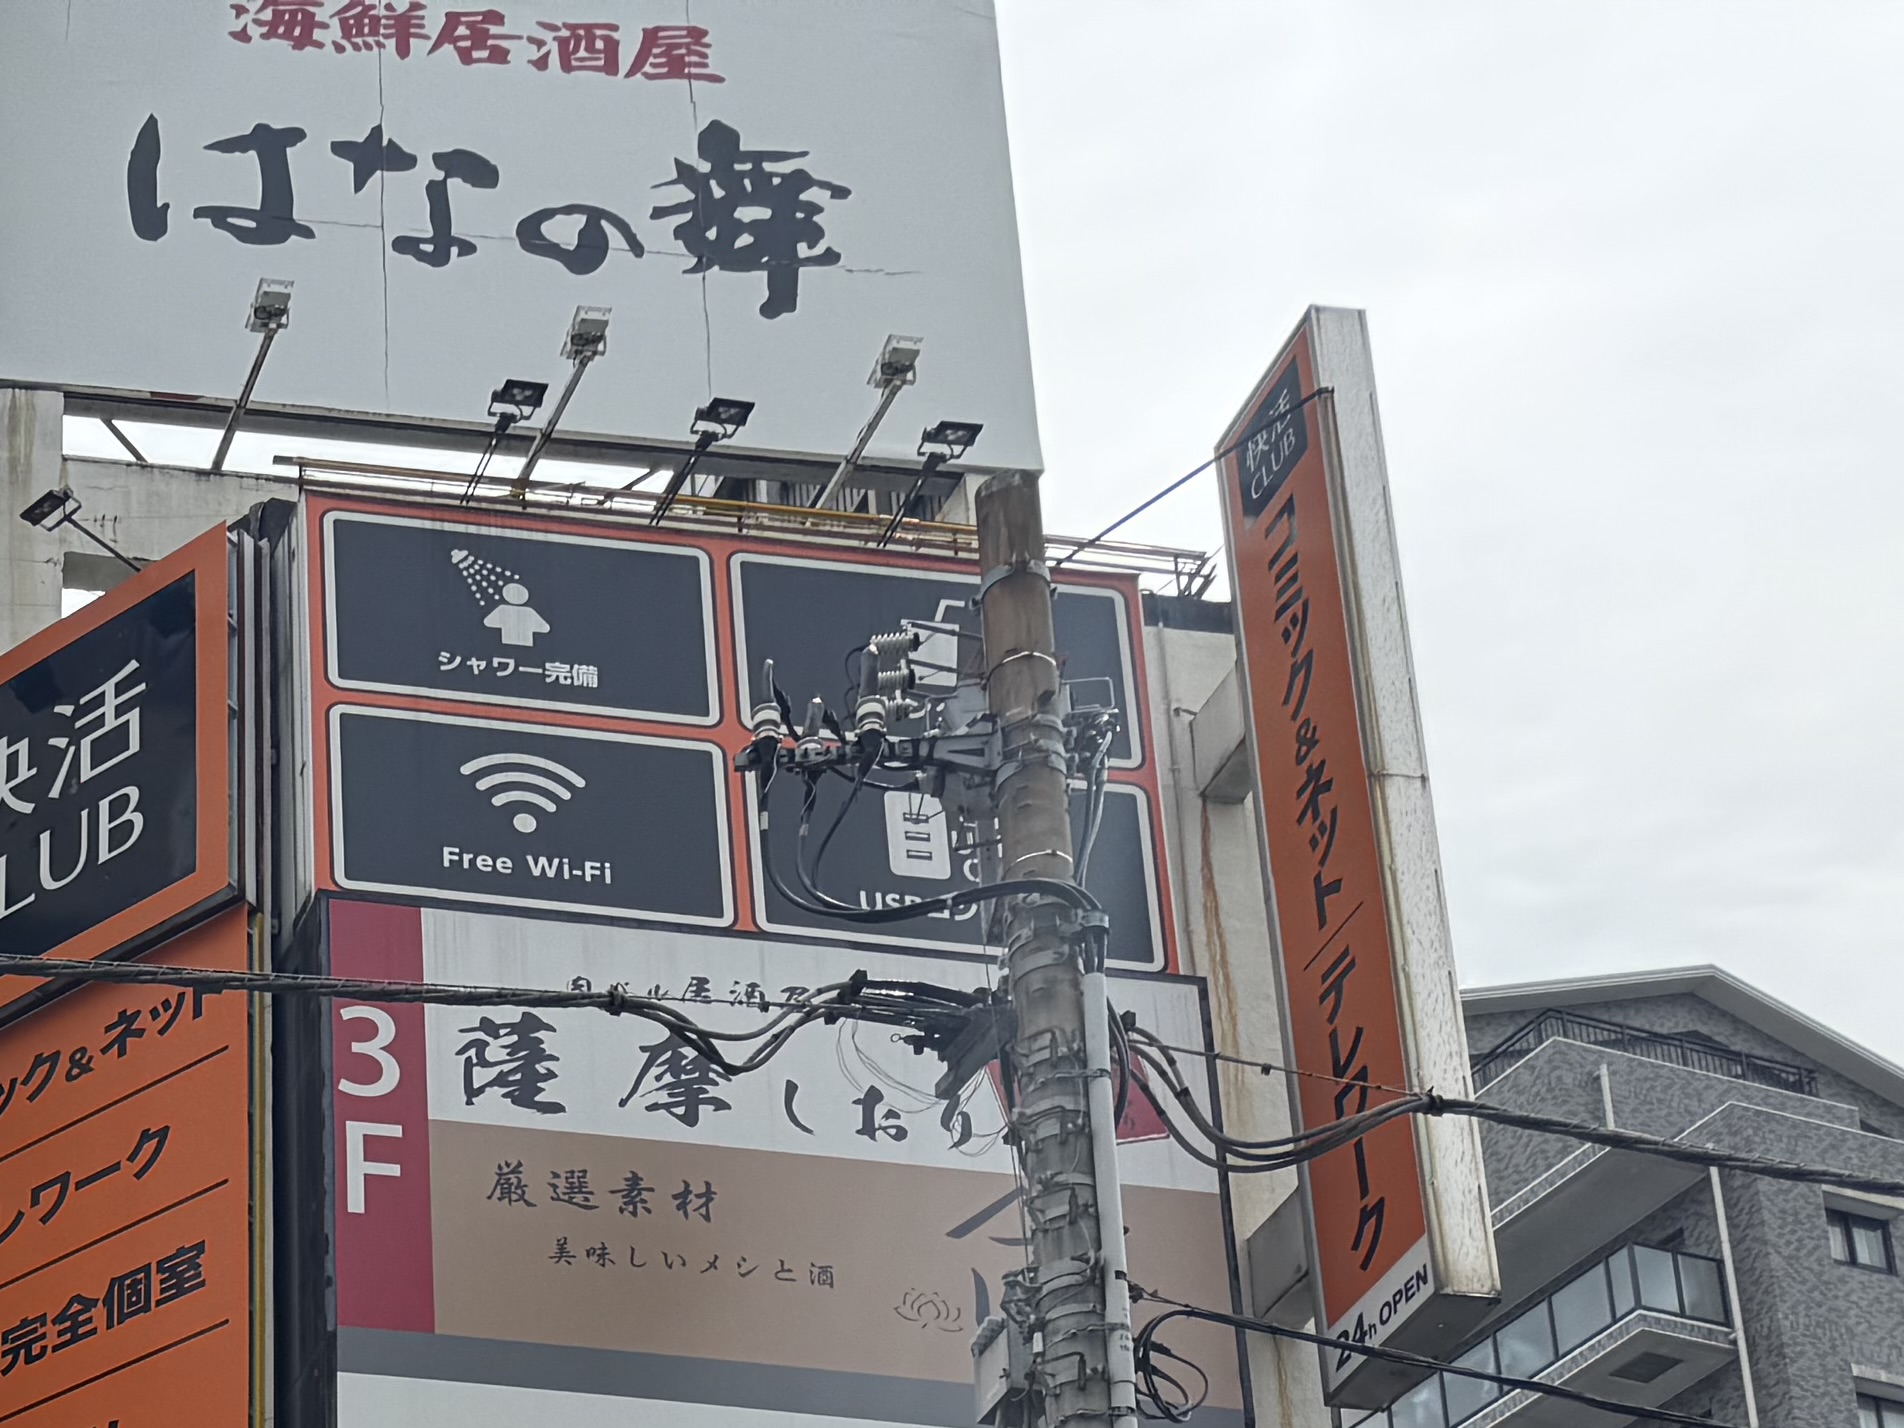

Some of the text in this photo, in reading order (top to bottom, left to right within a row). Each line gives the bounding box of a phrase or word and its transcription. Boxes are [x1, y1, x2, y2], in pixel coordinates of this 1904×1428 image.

[227, 0, 726, 84] 海鮮居酒屋
[126, 112, 852, 320] はなの舞
[1251, 428, 1296, 499] CLUB
[438, 651, 599, 690] シャワー完備
[442, 846, 613, 886] Free Wi-Fi
[486, 1160, 719, 1225] 厳選素材
[548, 1235, 835, 1291] 美味しいメシと酒
[1379, 1263, 1429, 1327] OPEN
